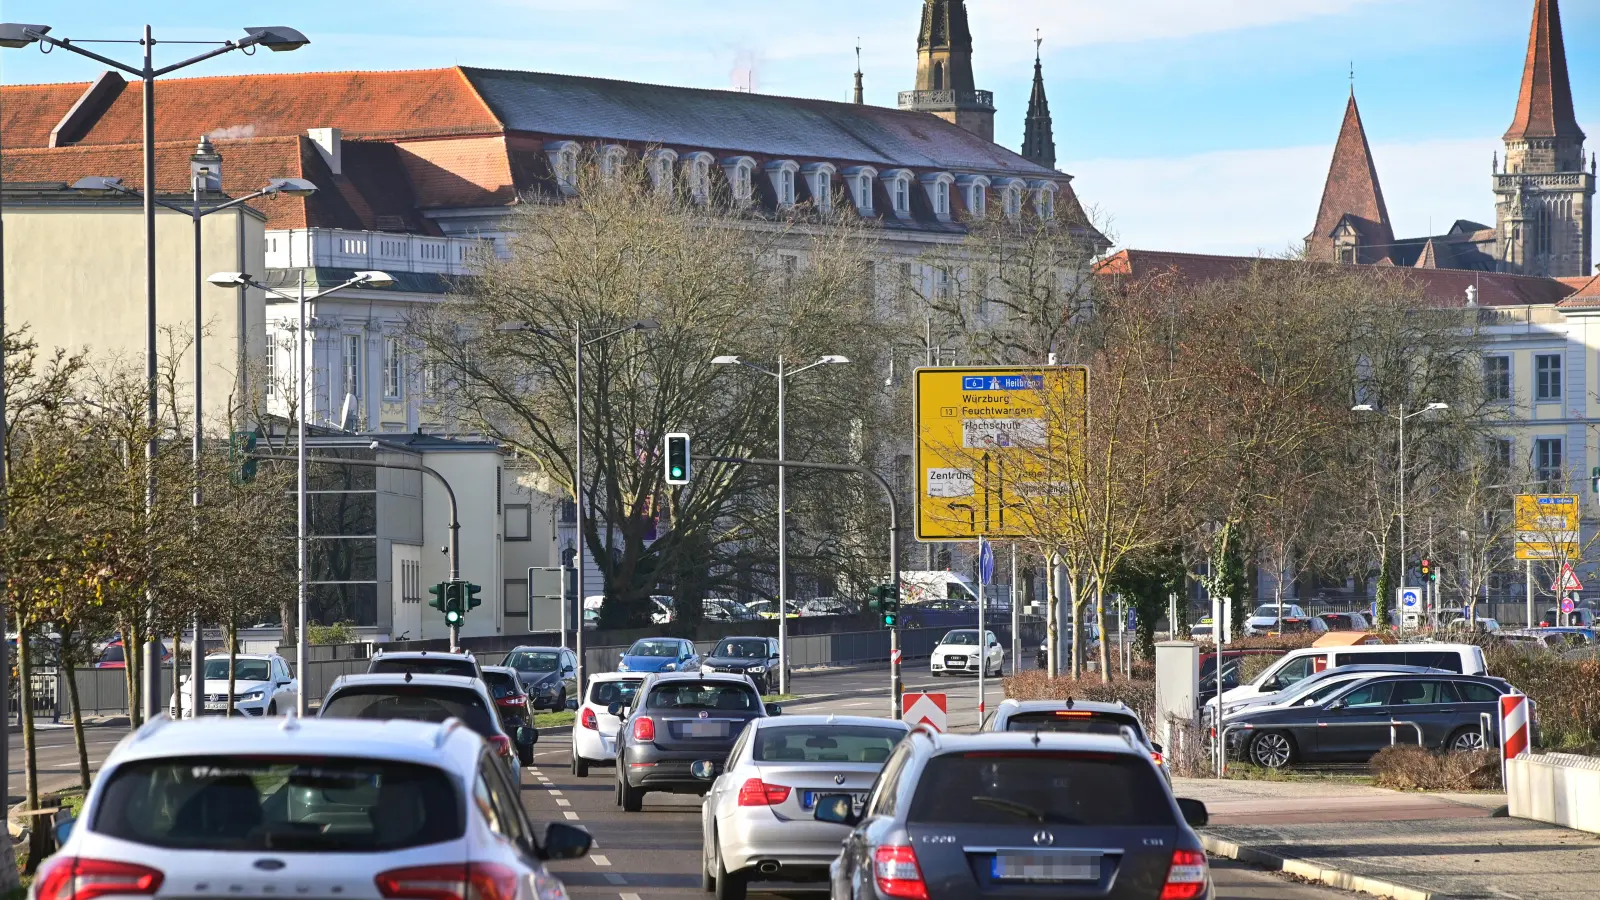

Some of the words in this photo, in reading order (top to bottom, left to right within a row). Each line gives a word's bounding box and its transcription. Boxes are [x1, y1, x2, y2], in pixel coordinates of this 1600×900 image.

[962, 394, 1010, 404] Würzburg
[945, 408, 953, 416] 13
[962, 406, 1033, 416] Feuchtwangen
[965, 421, 1020, 430] Hochschule
